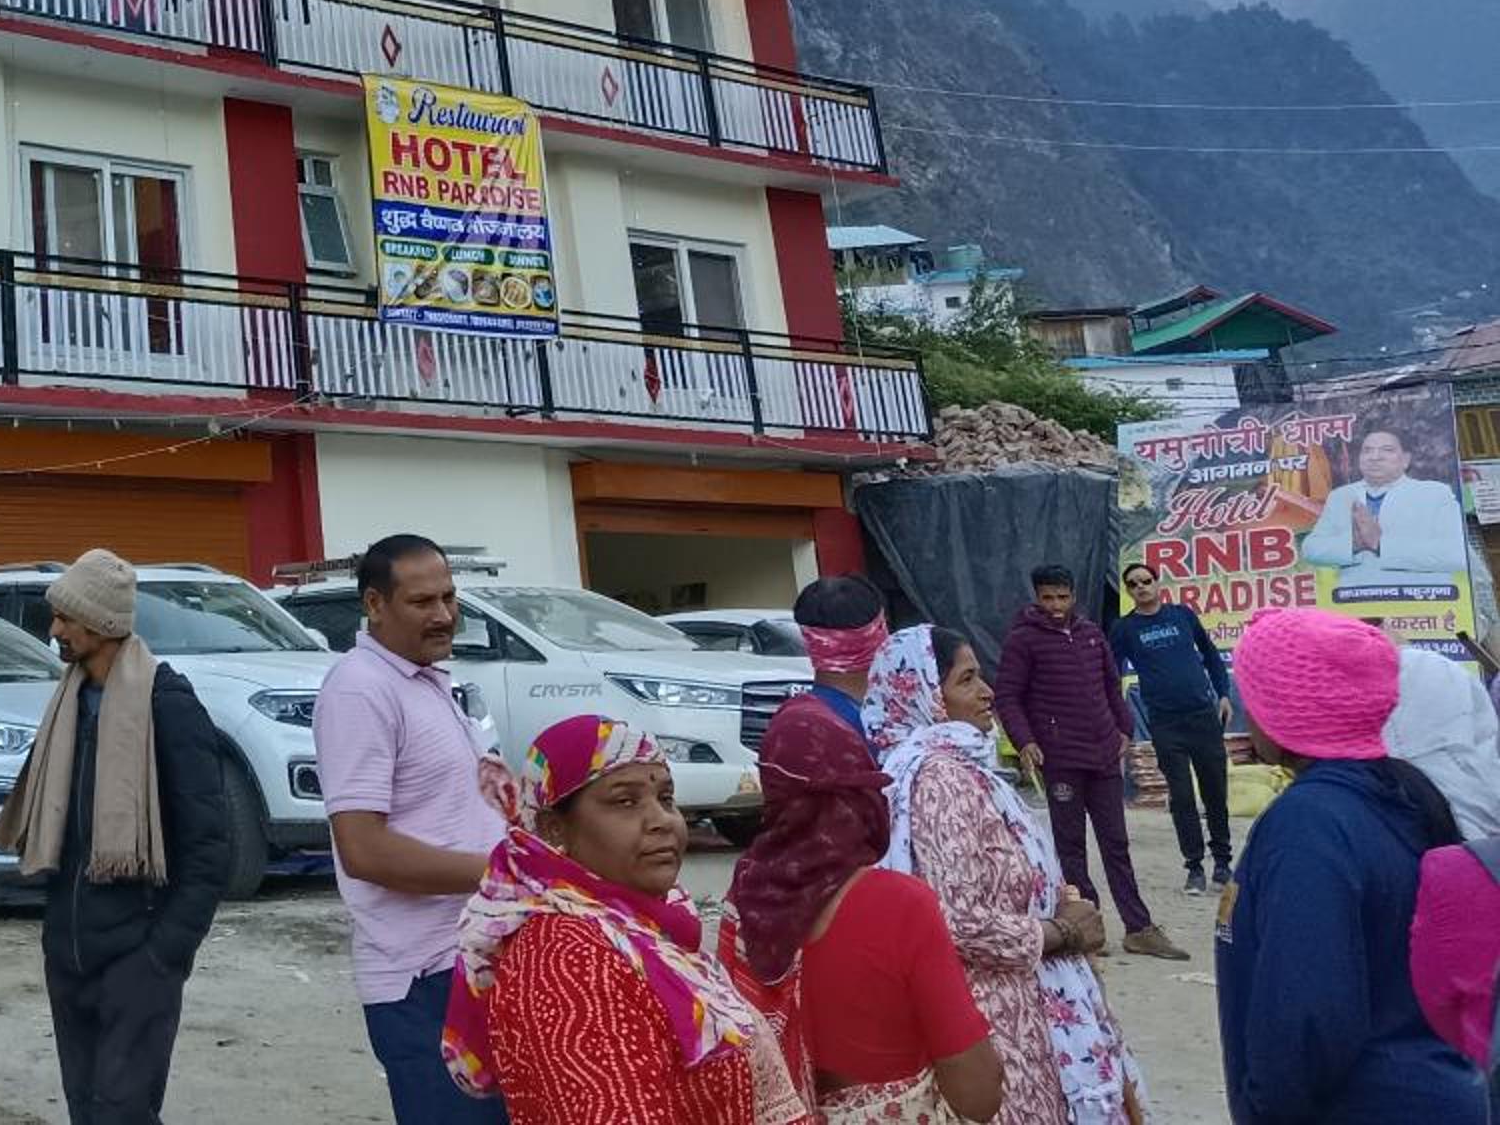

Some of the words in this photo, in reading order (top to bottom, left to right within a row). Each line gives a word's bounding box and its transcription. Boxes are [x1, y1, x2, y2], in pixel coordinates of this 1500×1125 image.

[408, 87, 527, 137] Restaurant
[390, 131, 527, 180] HOTEL
[383, 170, 431, 201] RNB
[437, 178, 542, 211] PARADISE
[1133, 415, 1270, 474] यमुनोत्री
[1280, 413, 1357, 448] धाम
[1188, 459, 1271, 485] आगमन
[1277, 454, 1309, 471] पर
[1157, 482, 1279, 534] Hotel
[1144, 526, 1296, 581] RNB
[1157, 573, 1317, 614] ARADISE
[528, 683, 603, 698] CRYSTA
